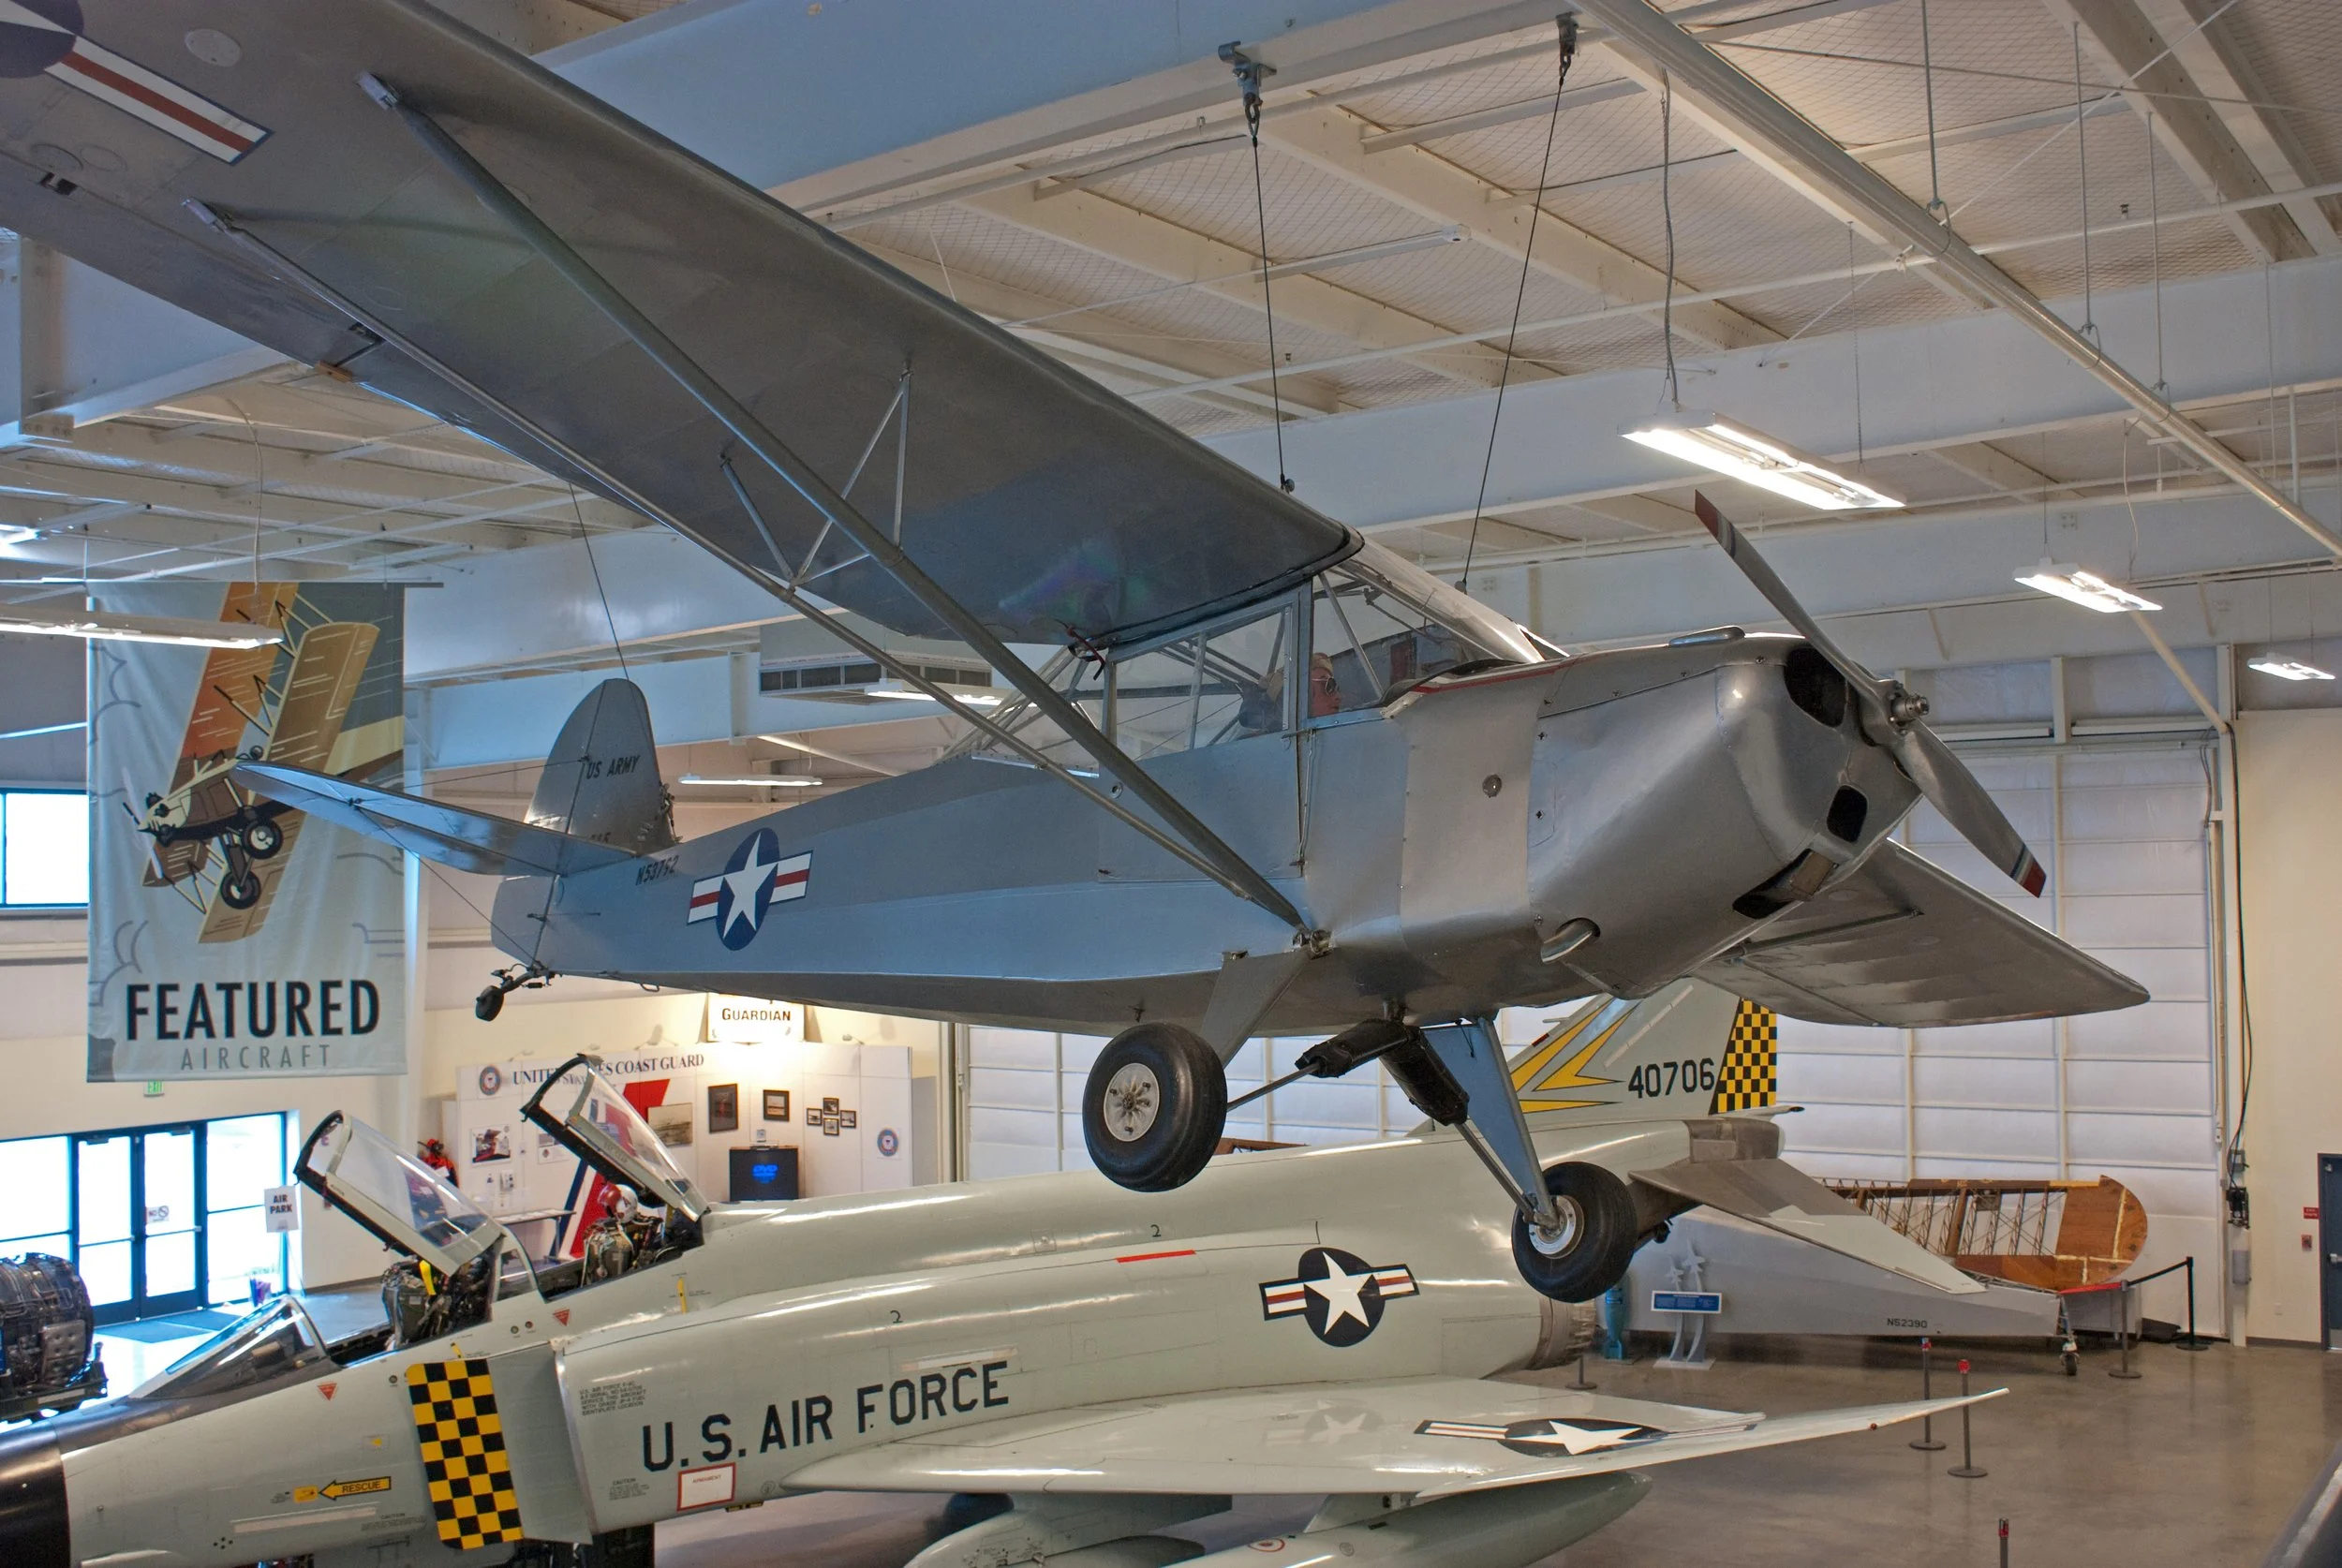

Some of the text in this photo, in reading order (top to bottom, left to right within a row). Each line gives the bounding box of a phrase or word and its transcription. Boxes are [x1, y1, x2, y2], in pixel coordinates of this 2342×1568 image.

[586, 755, 641, 779] US ARMY
[126, 979, 380, 1041] FEATURED
[721, 1008, 791, 1021] GUARDIAN
[181, 1044, 330, 1071] AIRCRAFT
[616, 1058, 658, 1075] COAST
[660, 1054, 704, 1071] GUARD
[1628, 1057, 1715, 1099] 40706
[273, 1194, 288, 1204] AIR
[270, 1204, 292, 1214] PARK
[1150, 1224, 1162, 1237] 2
[890, 1310, 903, 1324] 2
[1887, 1318, 1928, 1328] N52390
[760, 1395, 833, 1454] AIR
[856, 1360, 1009, 1433] FORCE
[342, 1480, 381, 1494] RESCUE
